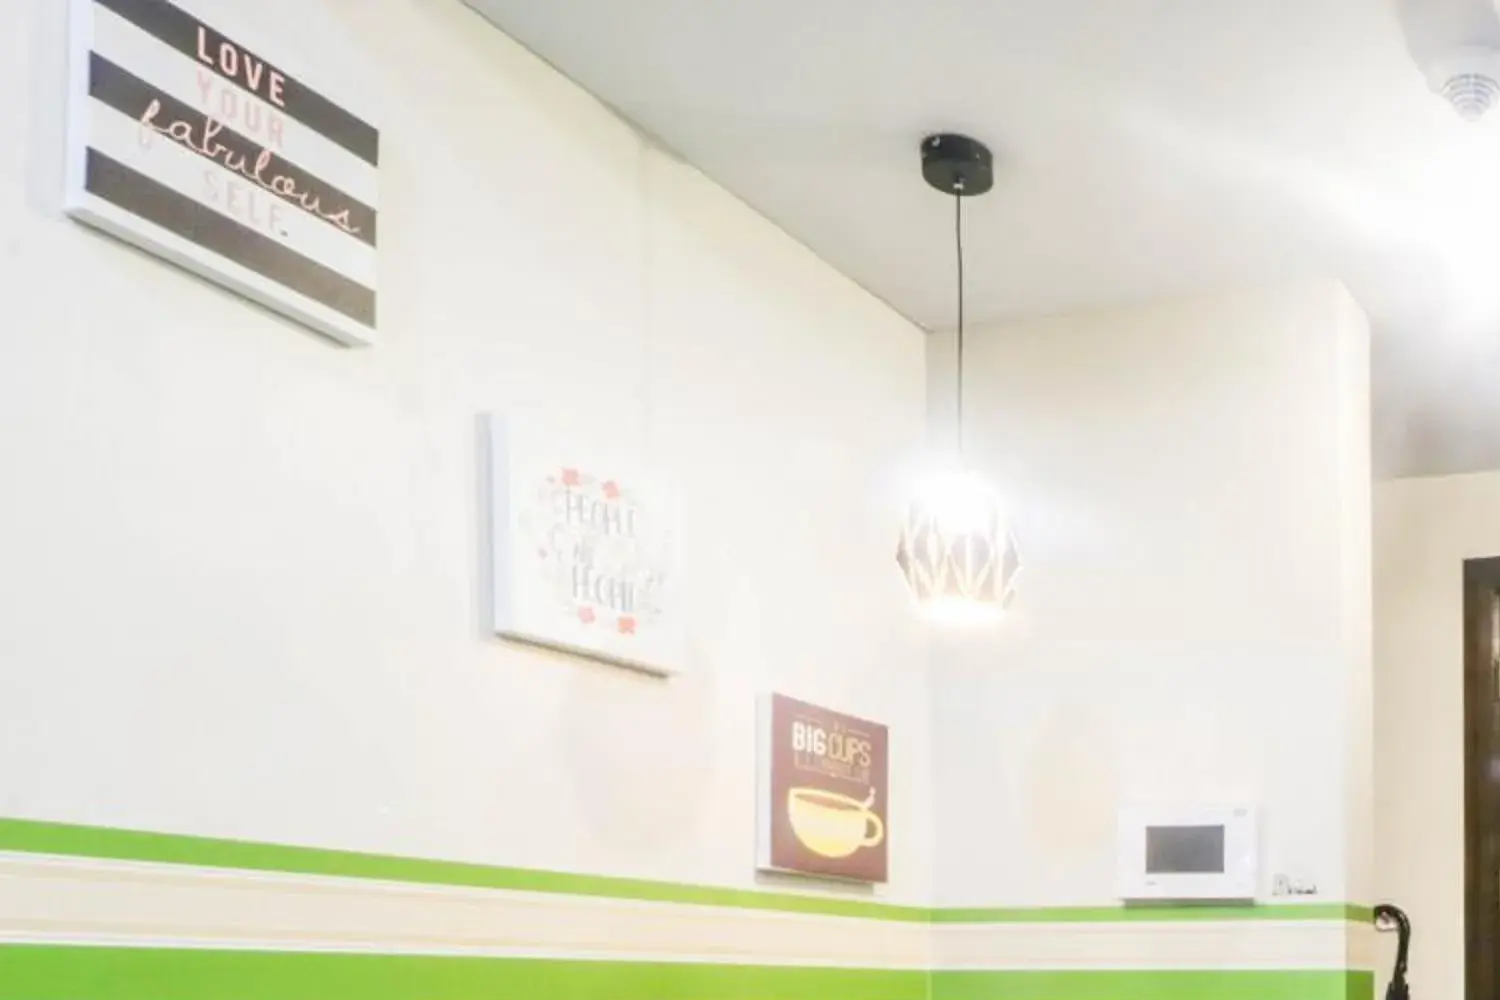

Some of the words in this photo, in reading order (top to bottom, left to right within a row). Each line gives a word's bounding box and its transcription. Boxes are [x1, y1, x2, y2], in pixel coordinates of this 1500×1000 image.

[195, 63, 284, 148] YOUR
[197, 26, 285, 108] LOVE
[792, 720, 827, 756] BIG
[828, 732, 872, 767] CUPS
